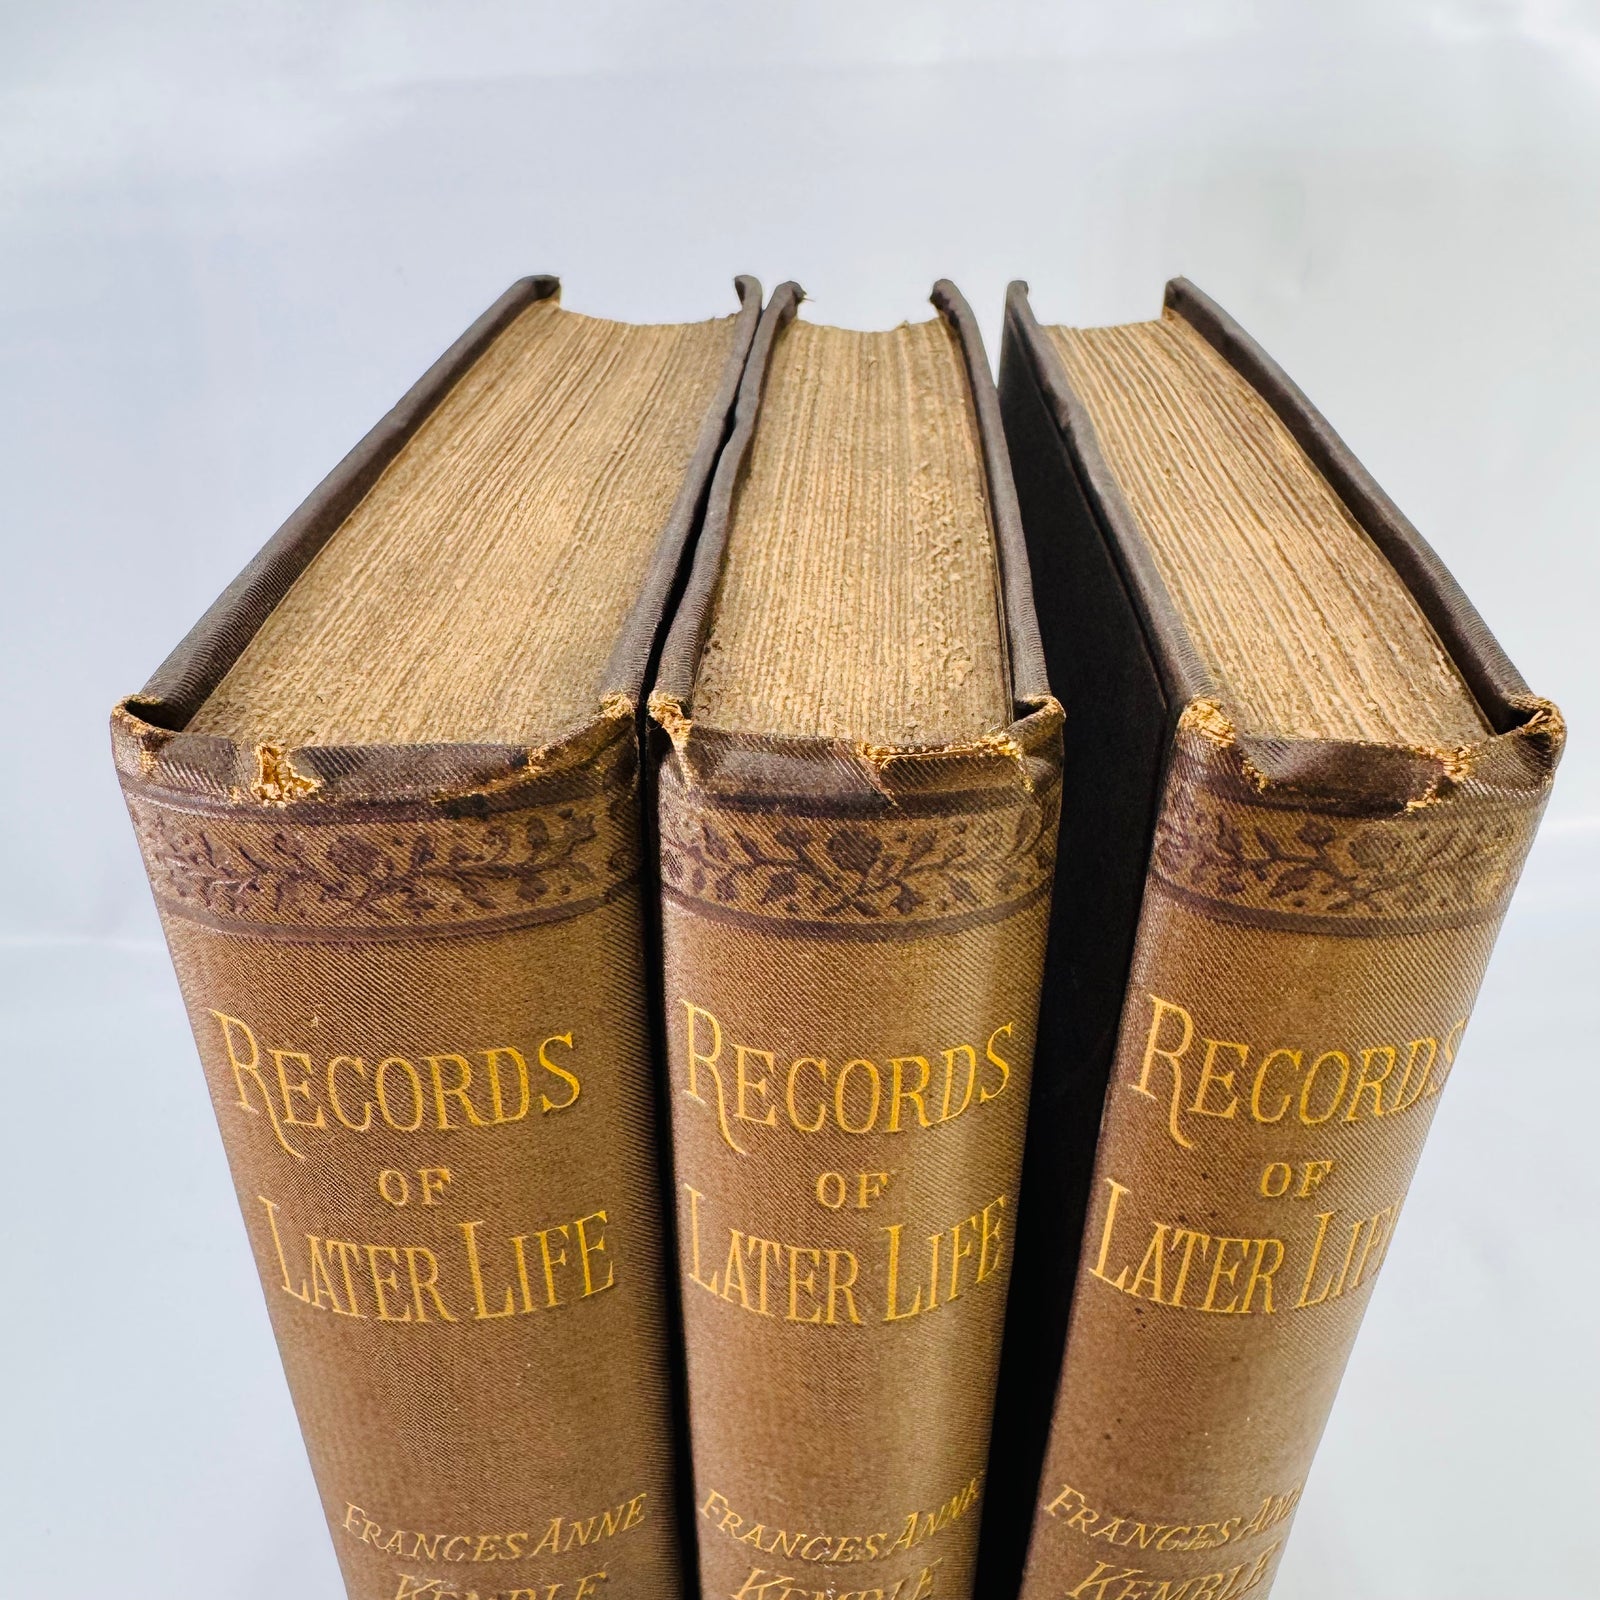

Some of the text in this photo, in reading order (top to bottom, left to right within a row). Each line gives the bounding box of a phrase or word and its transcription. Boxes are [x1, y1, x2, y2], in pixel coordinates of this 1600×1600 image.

[208, 1007, 580, 1159] RECORDS
[678, 999, 1014, 1155] RECORDS
[378, 1168, 452, 1206] OF
[816, 1172, 890, 1209] OF
[1259, 1159, 1334, 1199] OF
[257, 1194, 615, 1323] LATER LIFE
[684, 1182, 1006, 1325] LATER LIFE
[1088, 1177, 1399, 1314] LATER LIF
[342, 1492, 647, 1562] FRANCES ANNE
[699, 1488, 889, 1562] FRANCES
[1043, 1484, 1241, 1552] FRANCES
